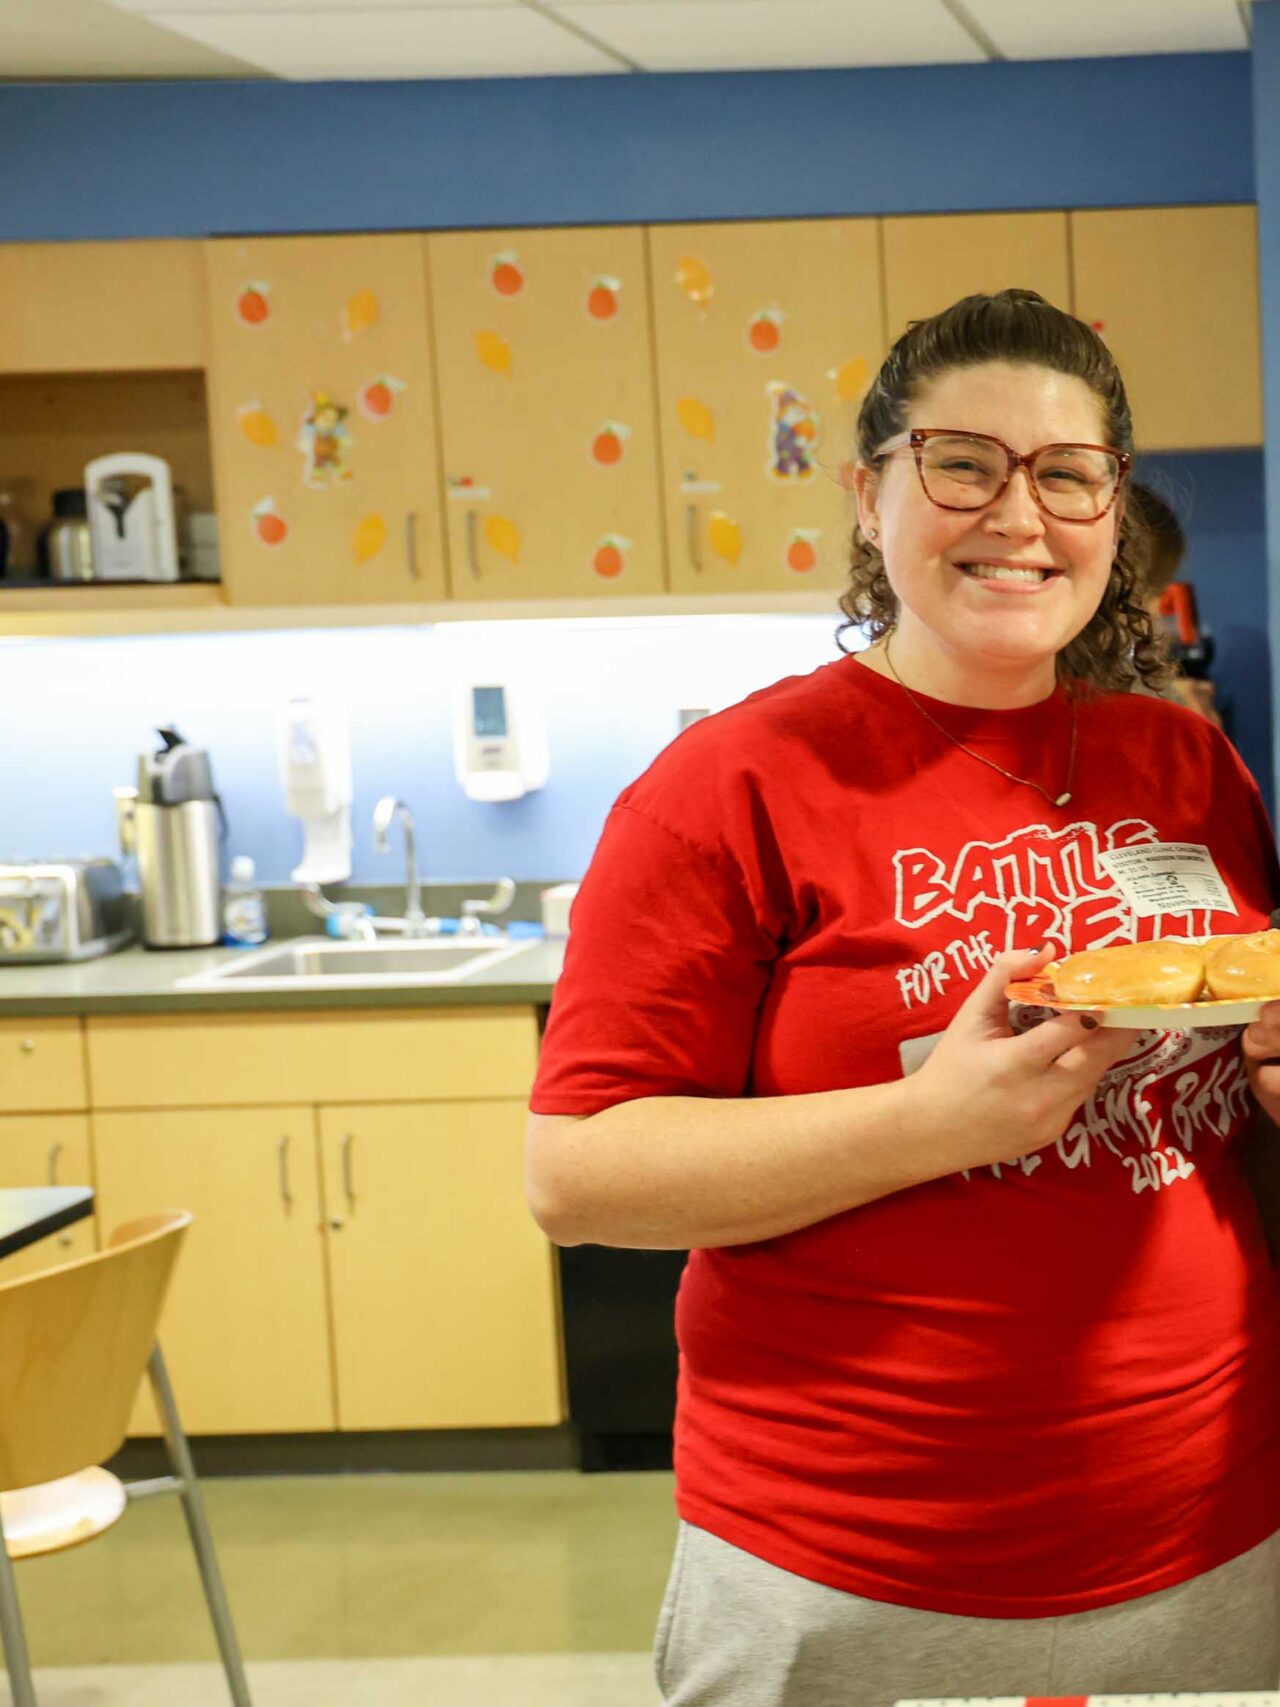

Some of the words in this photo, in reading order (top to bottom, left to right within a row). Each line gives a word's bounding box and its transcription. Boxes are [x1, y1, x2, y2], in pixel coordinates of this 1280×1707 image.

[895, 950, 951, 1010] FOR
[944, 930, 1001, 981] THE
[1055, 1072, 1164, 1169] GAME
[1122, 1146, 1197, 1194] 2022
